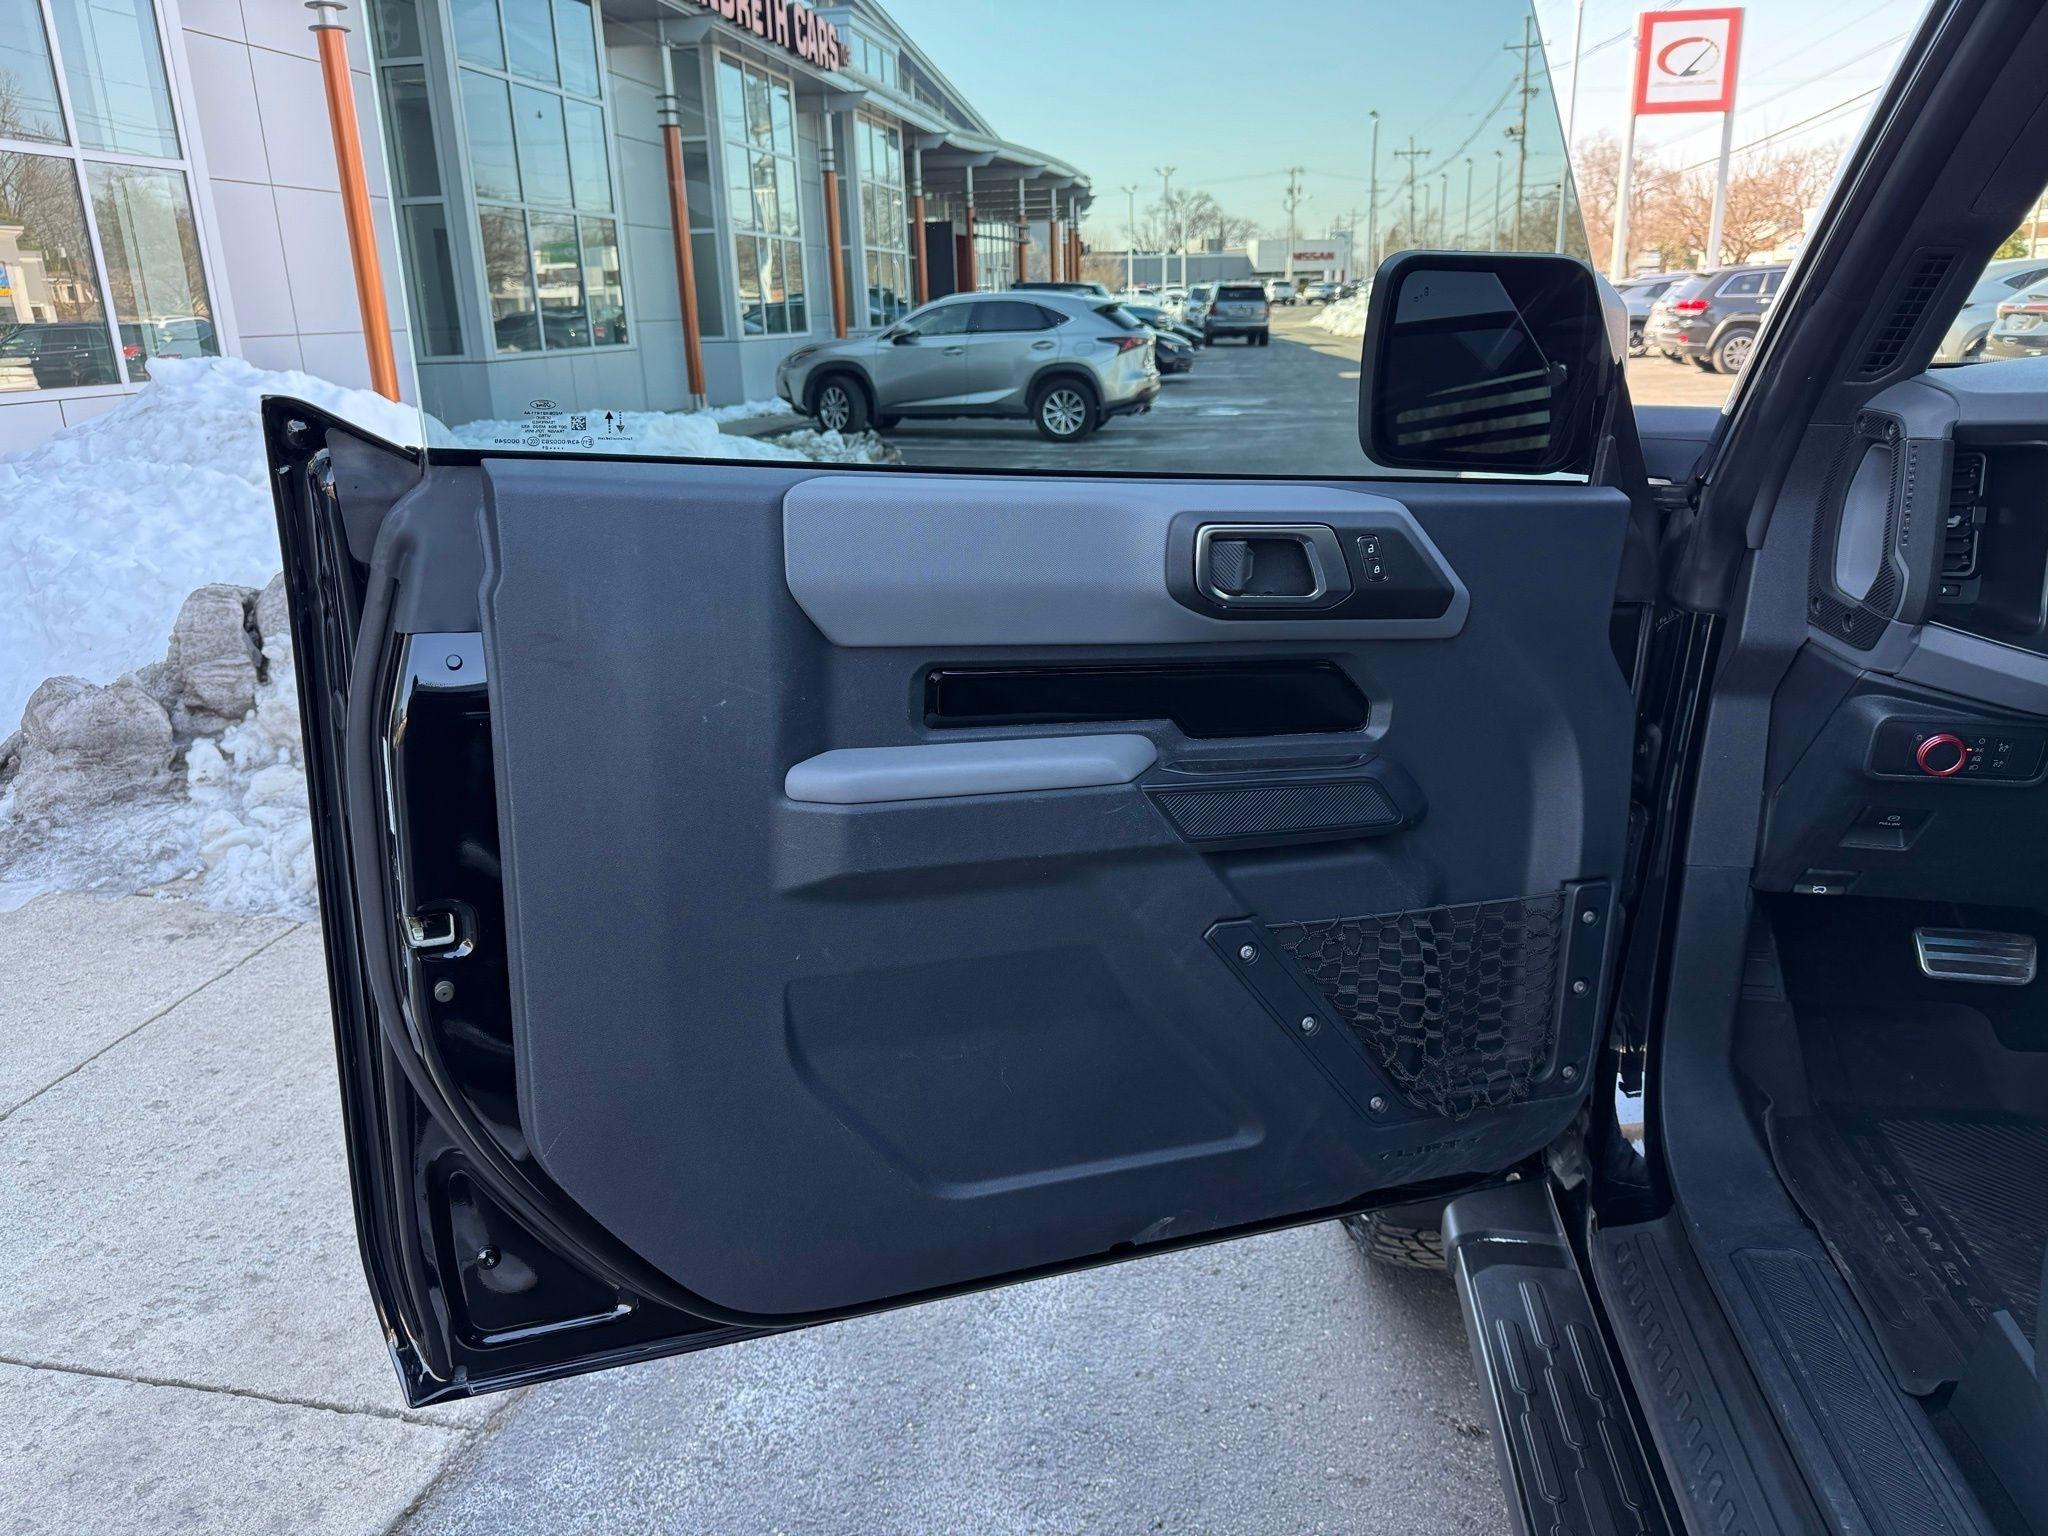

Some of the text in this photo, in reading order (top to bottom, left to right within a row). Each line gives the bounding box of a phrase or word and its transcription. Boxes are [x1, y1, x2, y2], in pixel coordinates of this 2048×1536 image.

[697, 0, 790, 49] RETH
[793, 3, 840, 72] CARS
[1293, 251, 1335, 261] NISSAN
